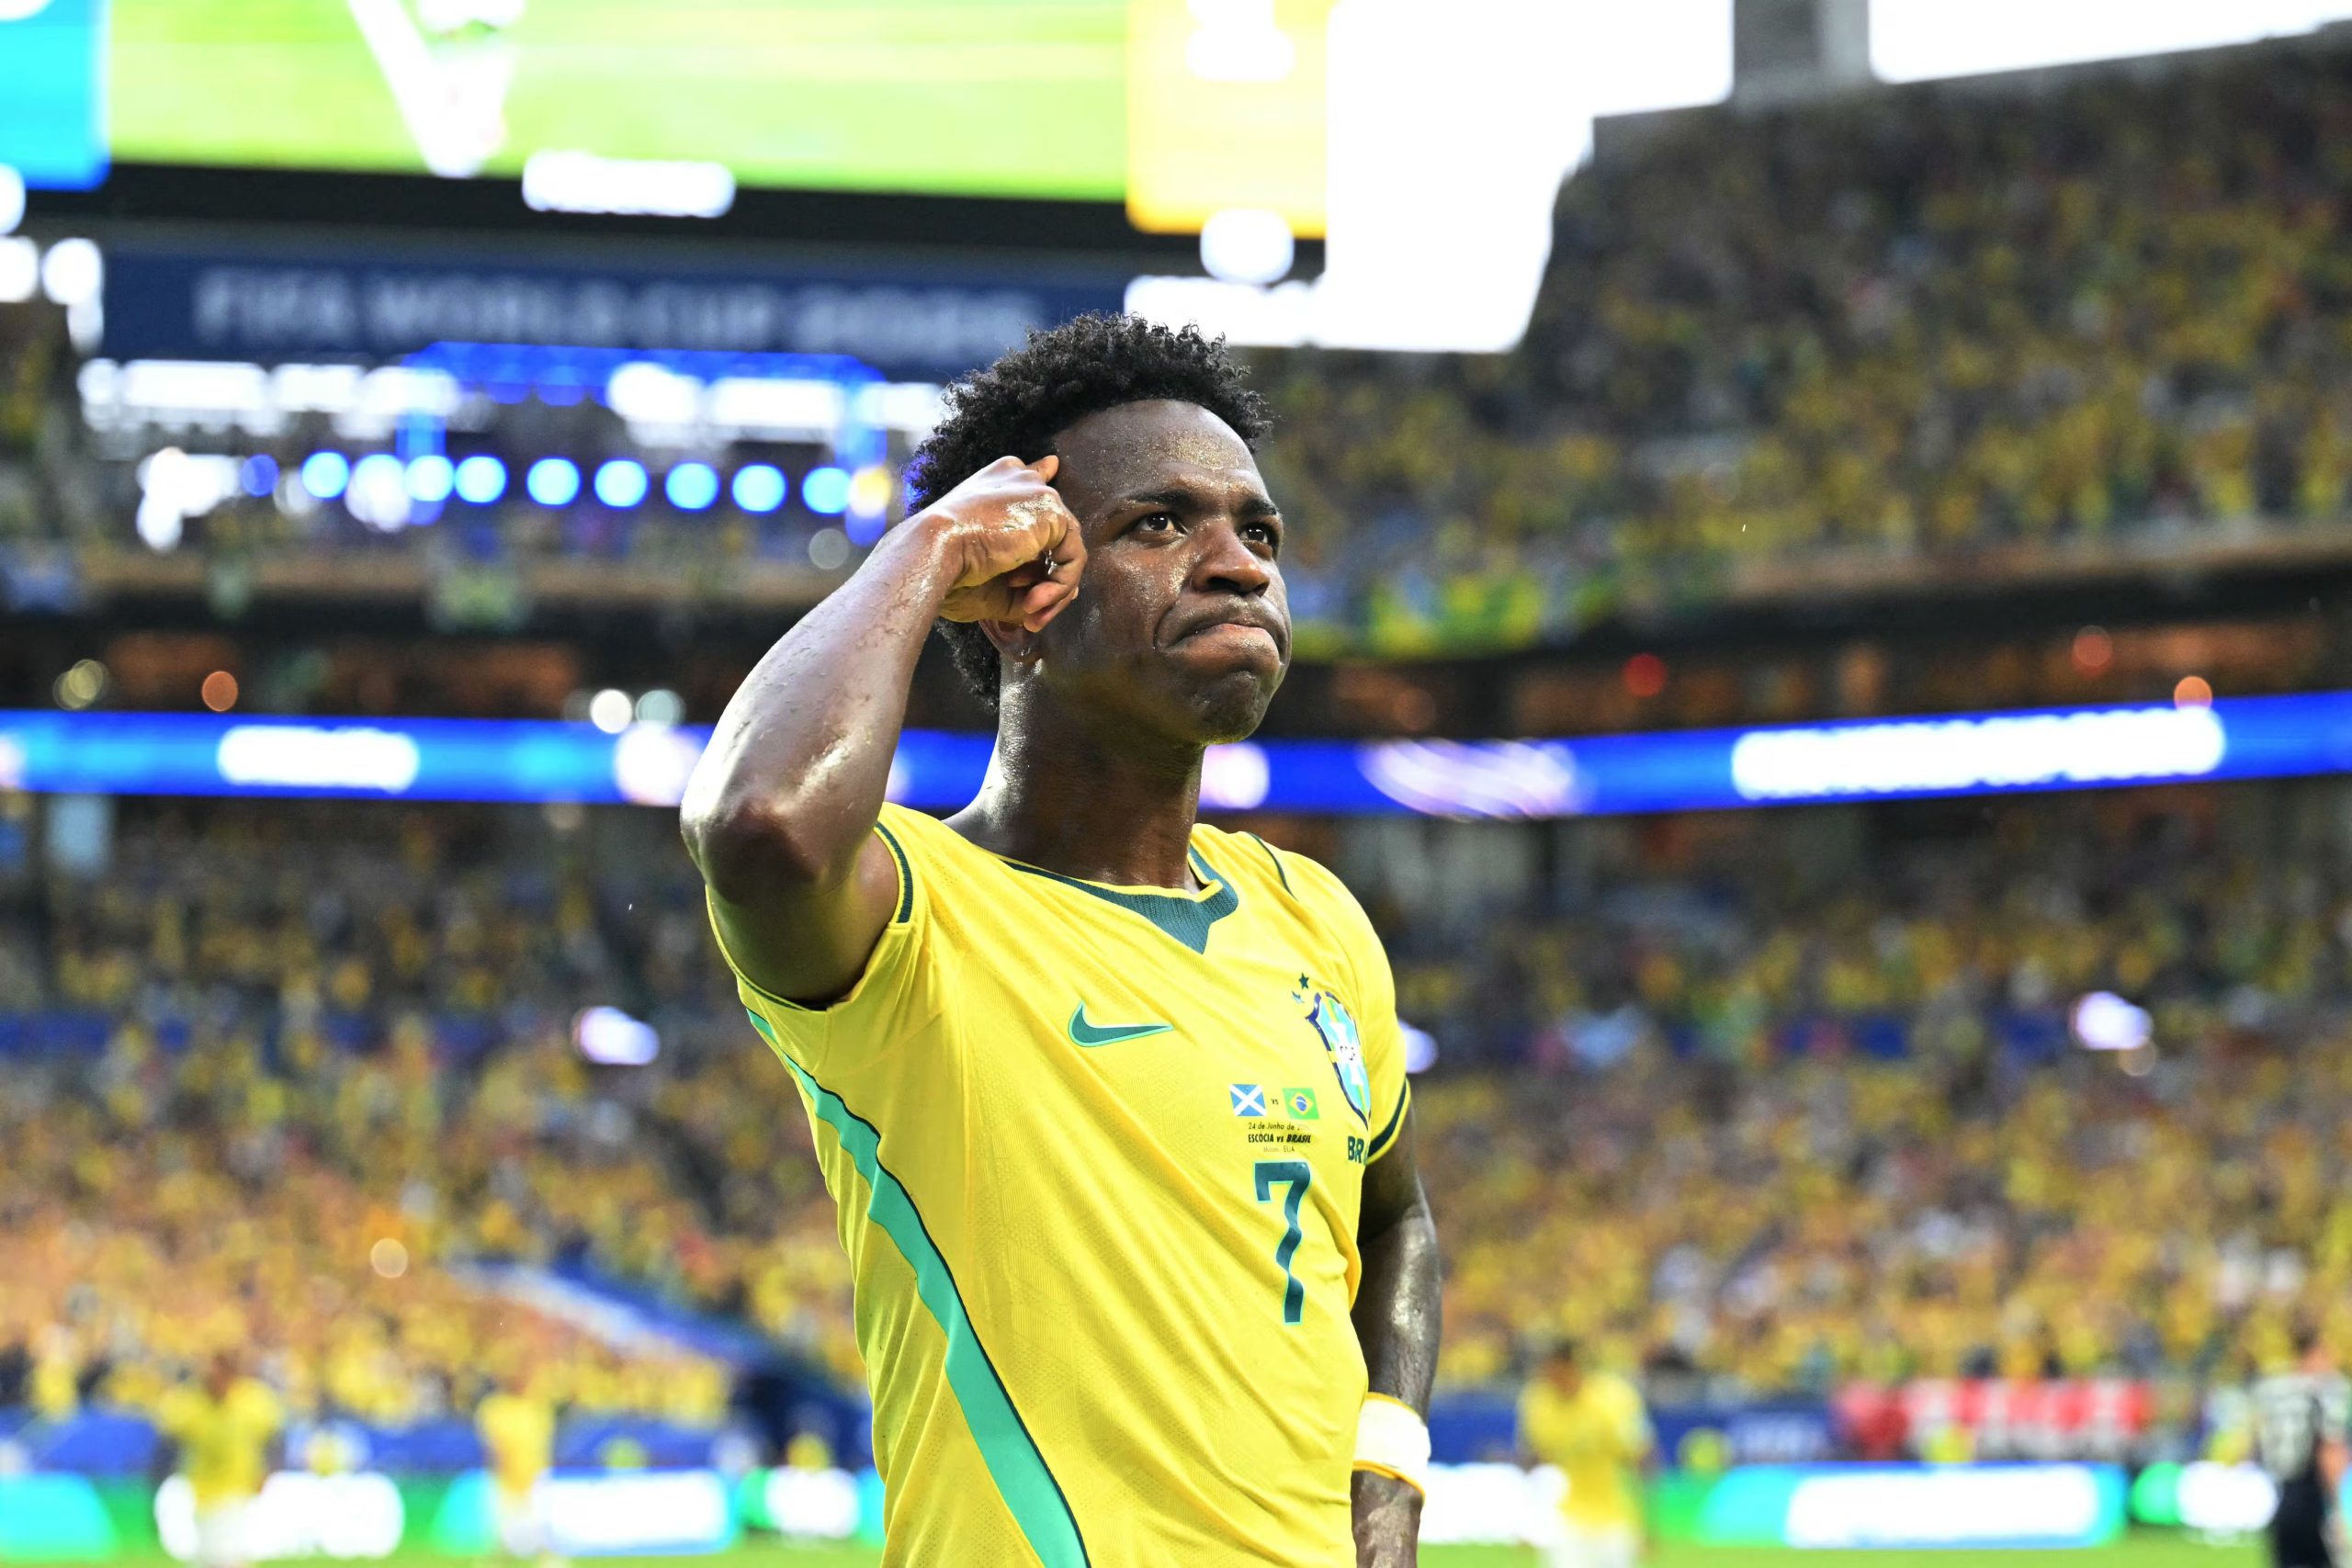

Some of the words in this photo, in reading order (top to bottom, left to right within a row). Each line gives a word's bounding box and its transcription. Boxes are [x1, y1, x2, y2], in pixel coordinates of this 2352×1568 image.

[196, 270, 356, 342] FIFA
[366, 275, 628, 345] WORLD
[638, 281, 778, 351] CUP
[1248, 1122, 1256, 1130] 24
[1258, 1122, 1265, 1130] de
[1266, 1122, 1284, 1130] Junho
[1286, 1122, 1295, 1131] de
[1248, 1131, 1274, 1143] ESCÓCIA
[1286, 1134, 1312, 1144] BRASIL
[1348, 1135, 1368, 1166] BR
[1253, 1160, 1312, 1325] 7
